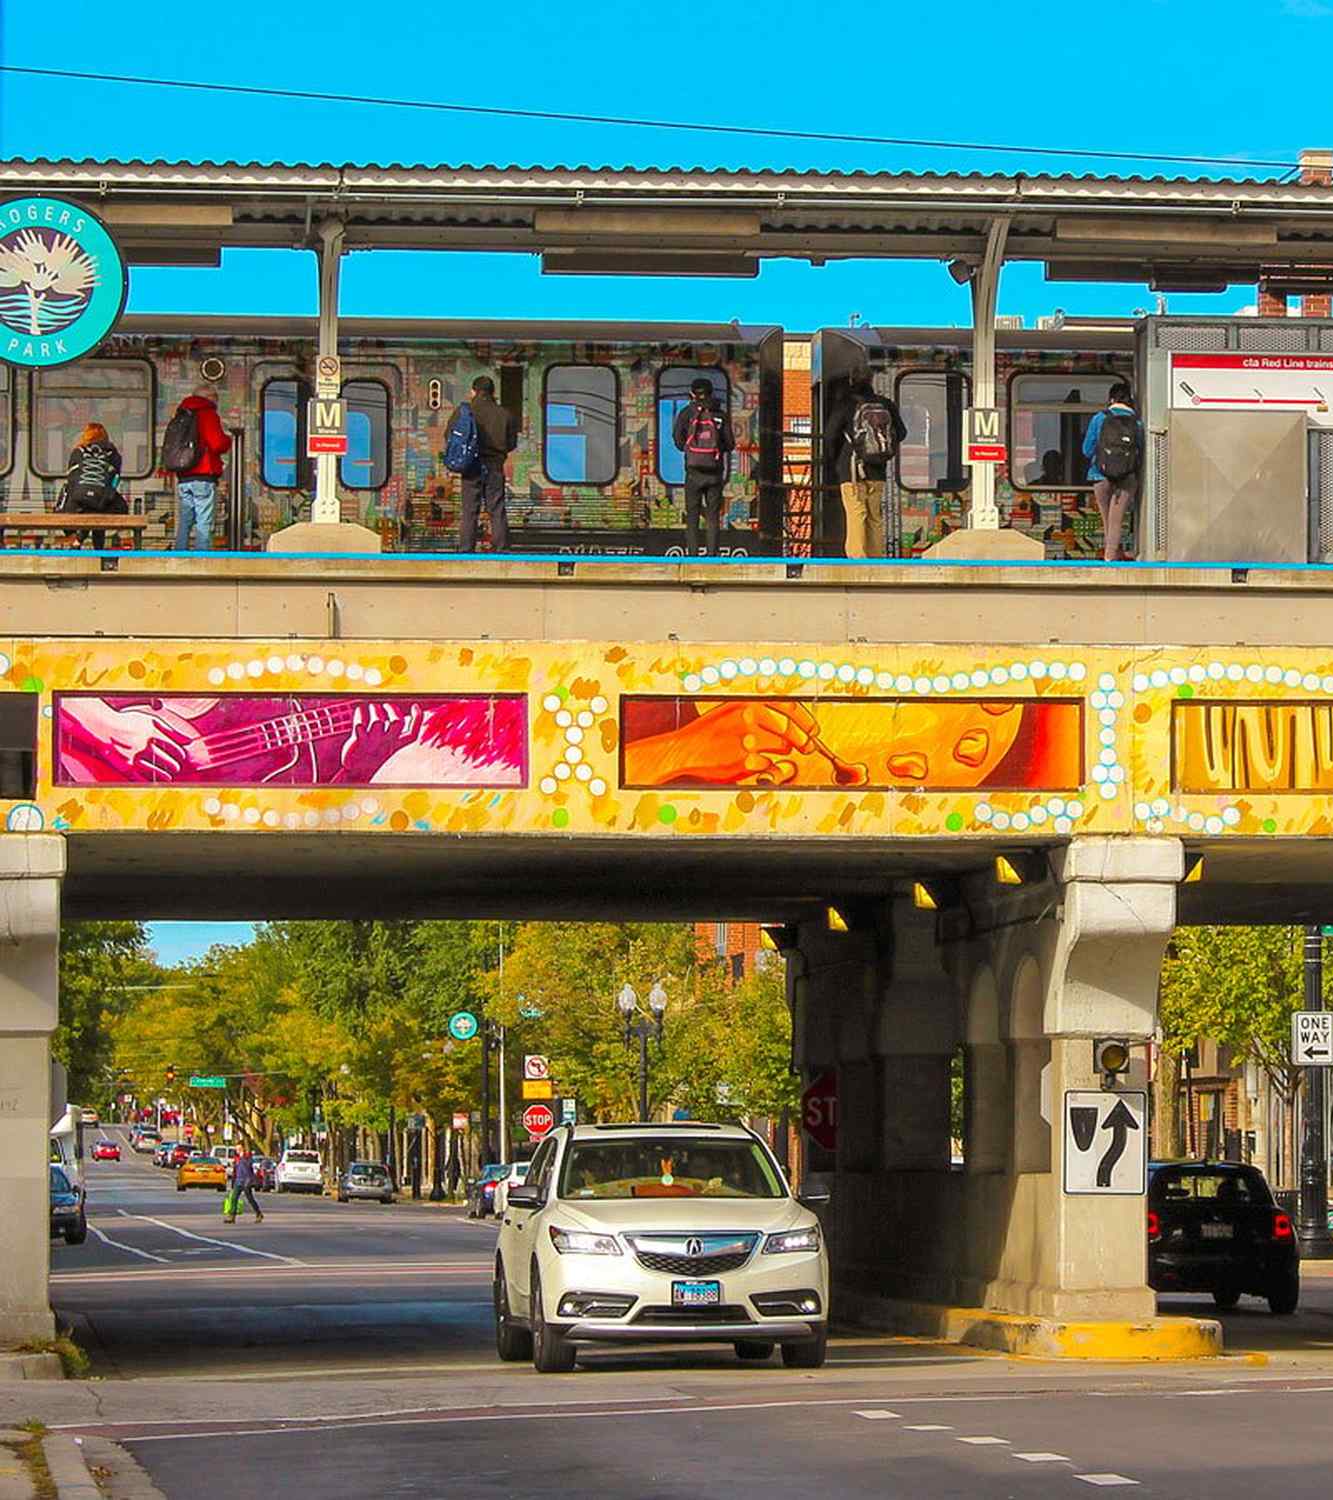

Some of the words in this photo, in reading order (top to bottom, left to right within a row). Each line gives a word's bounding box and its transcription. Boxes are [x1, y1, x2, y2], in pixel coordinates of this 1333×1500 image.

[0, 204, 86, 233] OGERS
[8, 338, 67, 357] PARK
[1261, 358, 1281, 368] Red
[1283, 359, 1304, 369] Line
[1306, 359, 1333, 369] trains
[316, 402, 340, 427] M
[975, 411, 999, 436] M
[1301, 1017, 1329, 1030] ONE
[1301, 1031, 1330, 1044] WAY
[525, 1114, 551, 1126] STOP
[807, 1096, 838, 1127] ST
